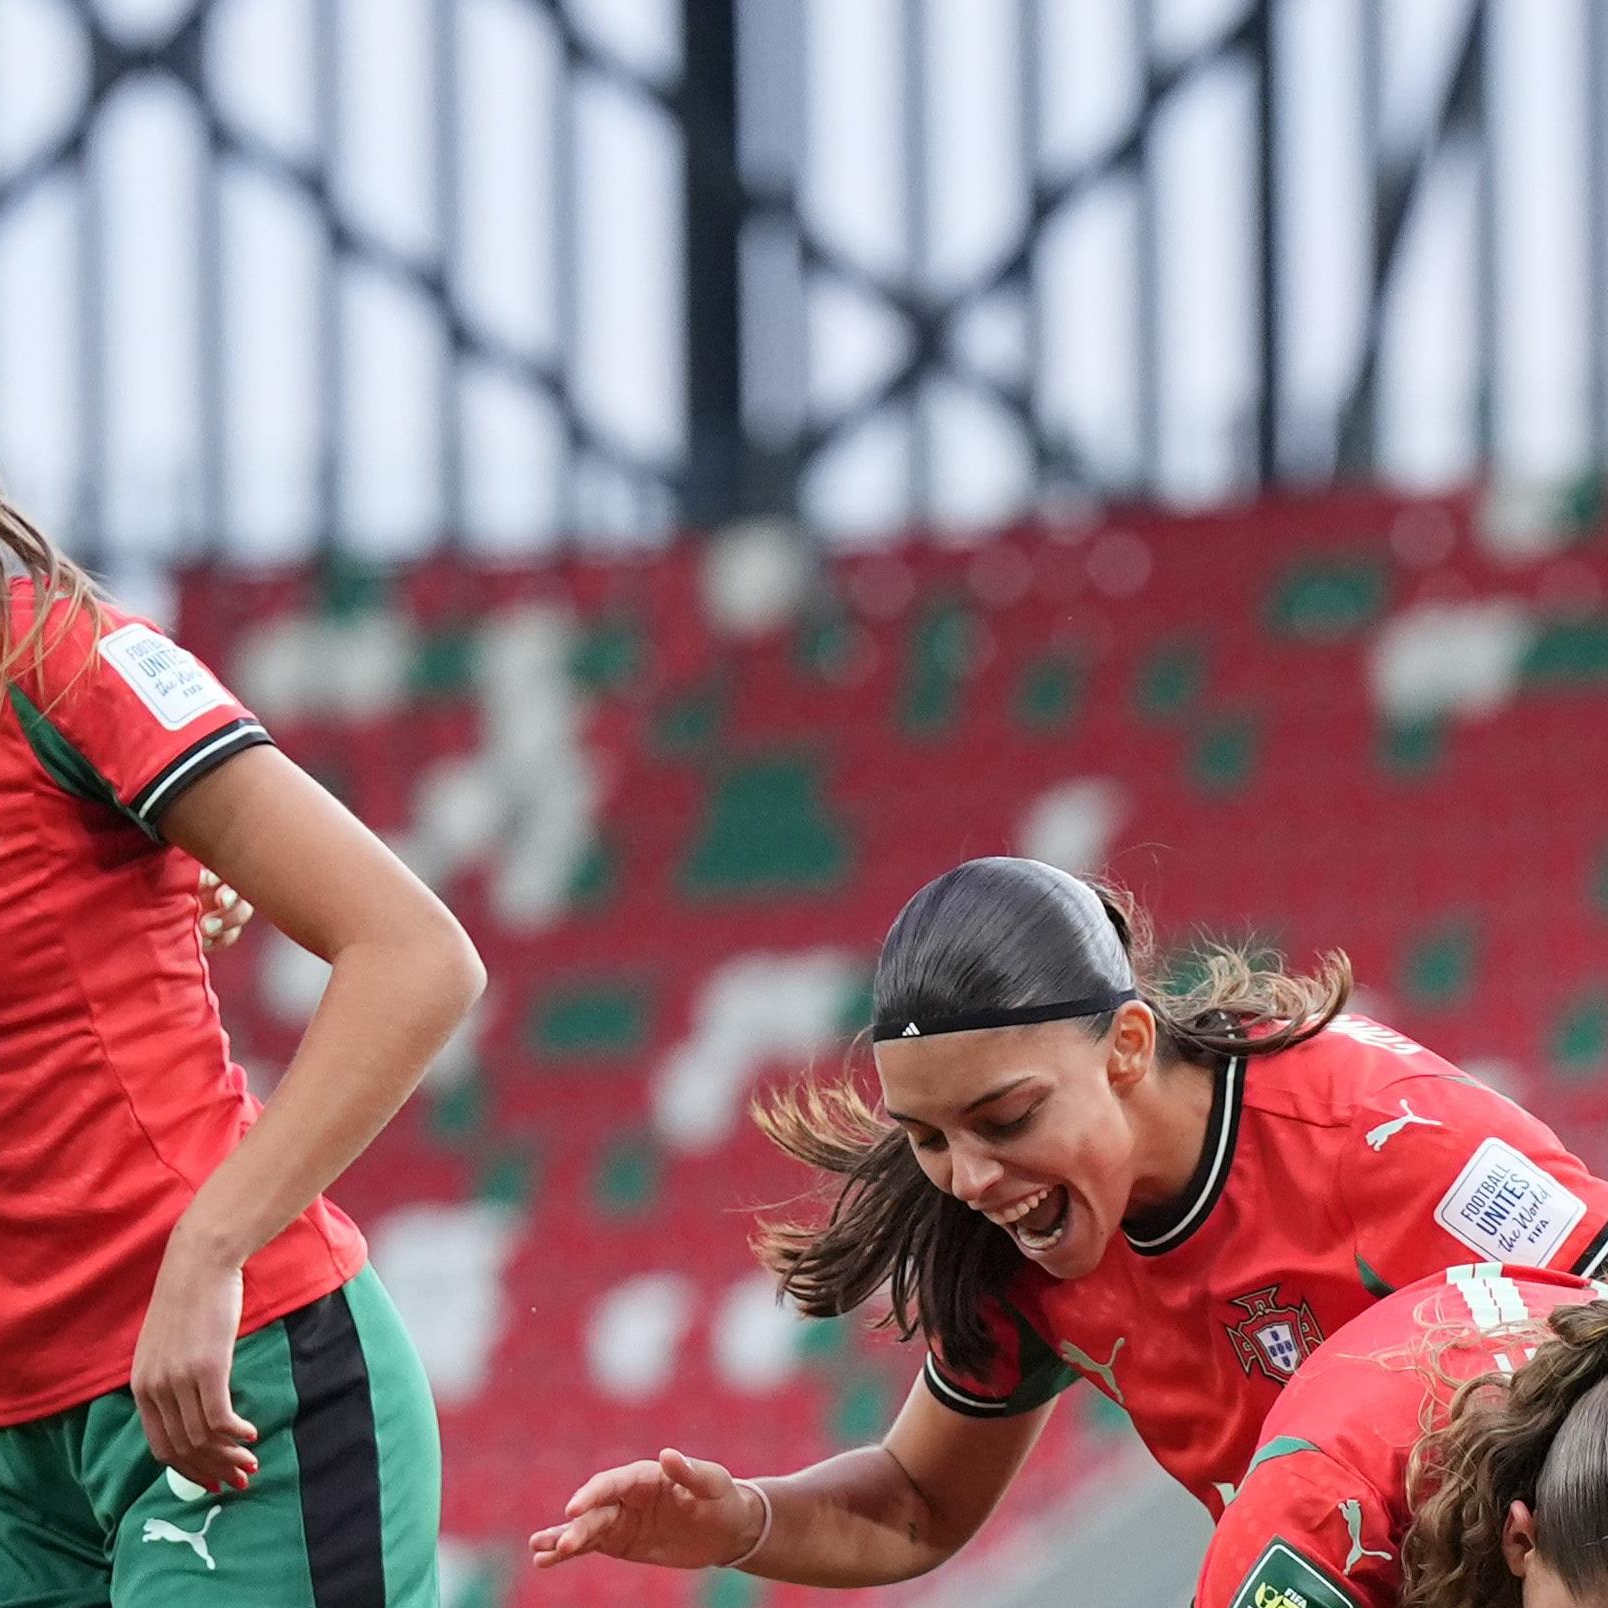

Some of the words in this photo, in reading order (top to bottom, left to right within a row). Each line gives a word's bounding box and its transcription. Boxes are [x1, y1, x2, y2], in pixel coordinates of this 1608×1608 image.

[1460, 1163, 1511, 1223] FOOTBALL
[1476, 1173, 1530, 1236] UNITES
[1498, 1228, 1522, 1253] the
[1511, 1183, 1552, 1230] World
[1527, 1219, 1549, 1244] FIFA
